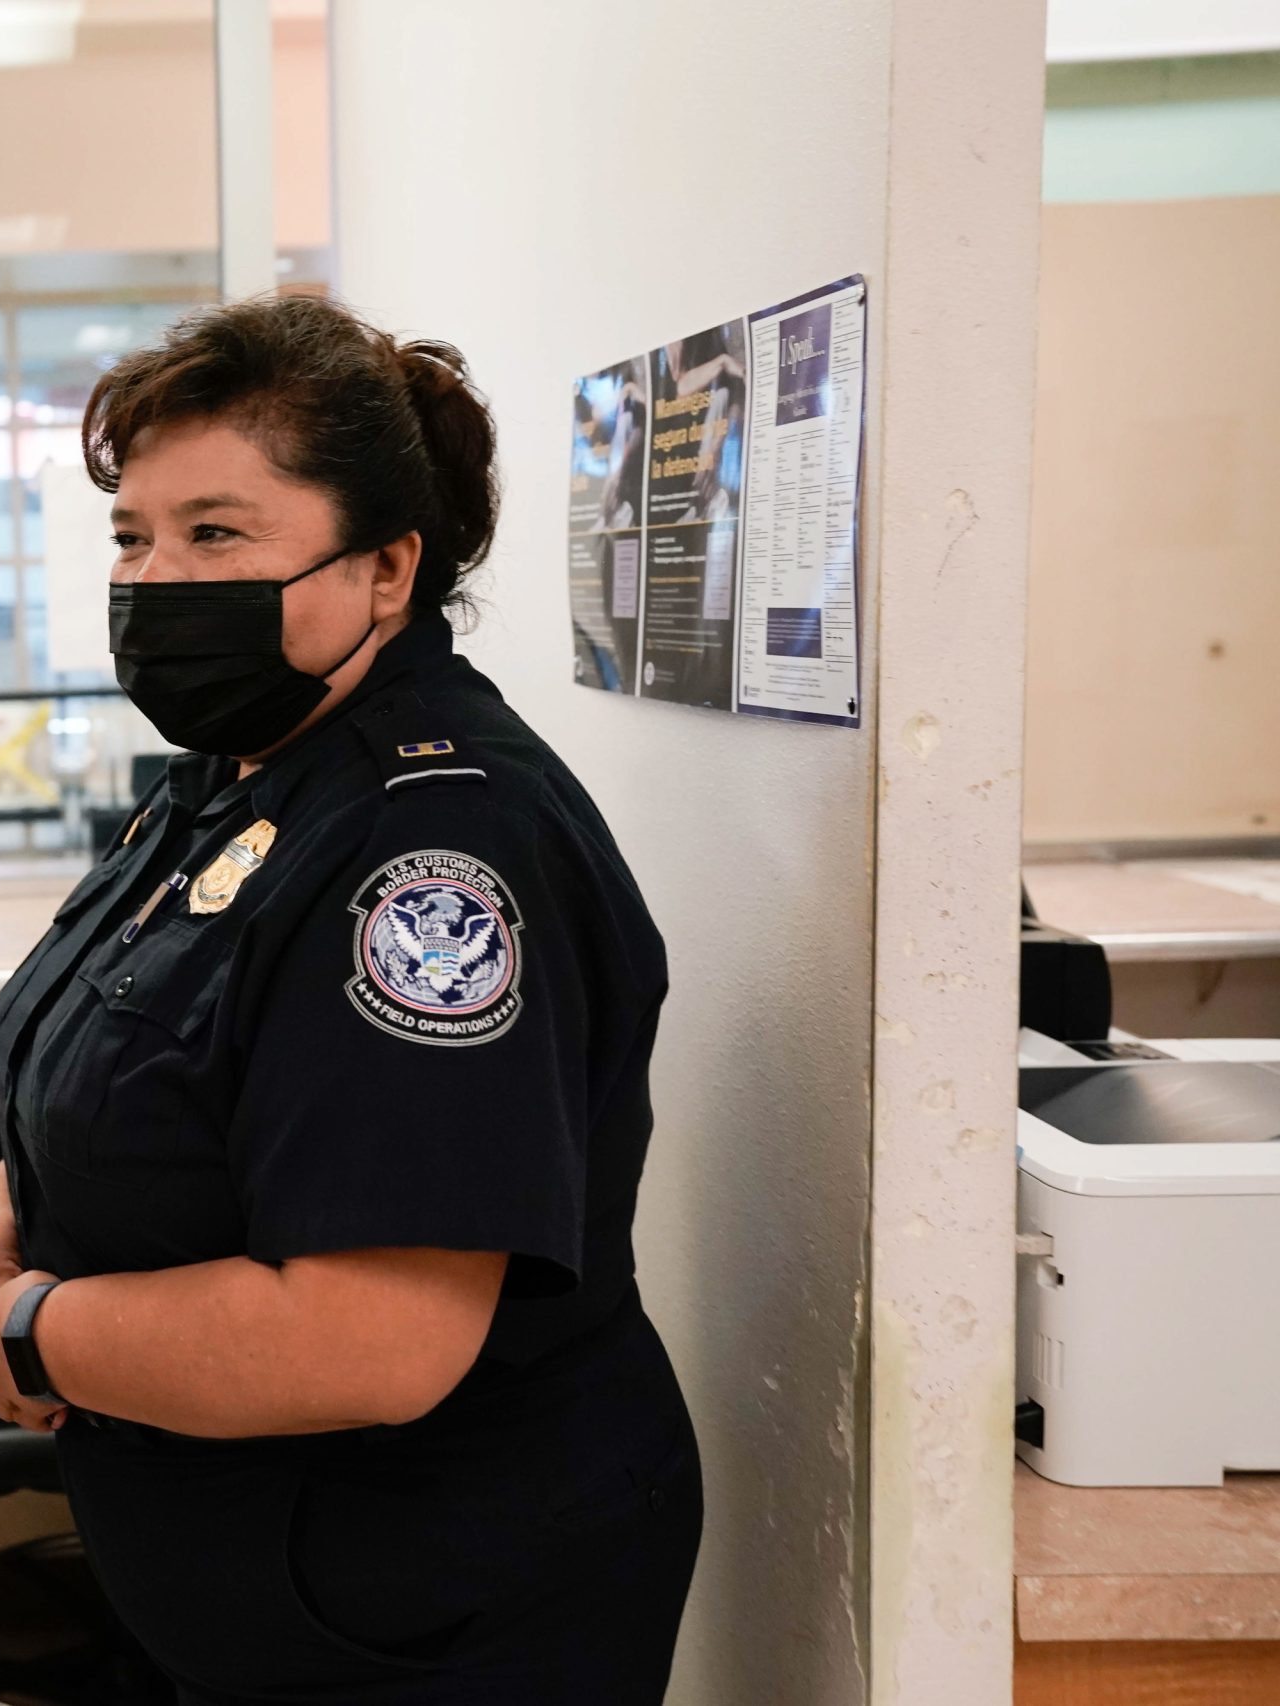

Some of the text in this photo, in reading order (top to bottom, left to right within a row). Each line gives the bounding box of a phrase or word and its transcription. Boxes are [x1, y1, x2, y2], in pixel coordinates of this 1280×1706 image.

[376, 866, 505, 909] BORDER PROTECTION
[386, 856, 496, 889] U.S. CUSTOMS AND
[379, 1003, 495, 1035] FIELD OPERATIONS
